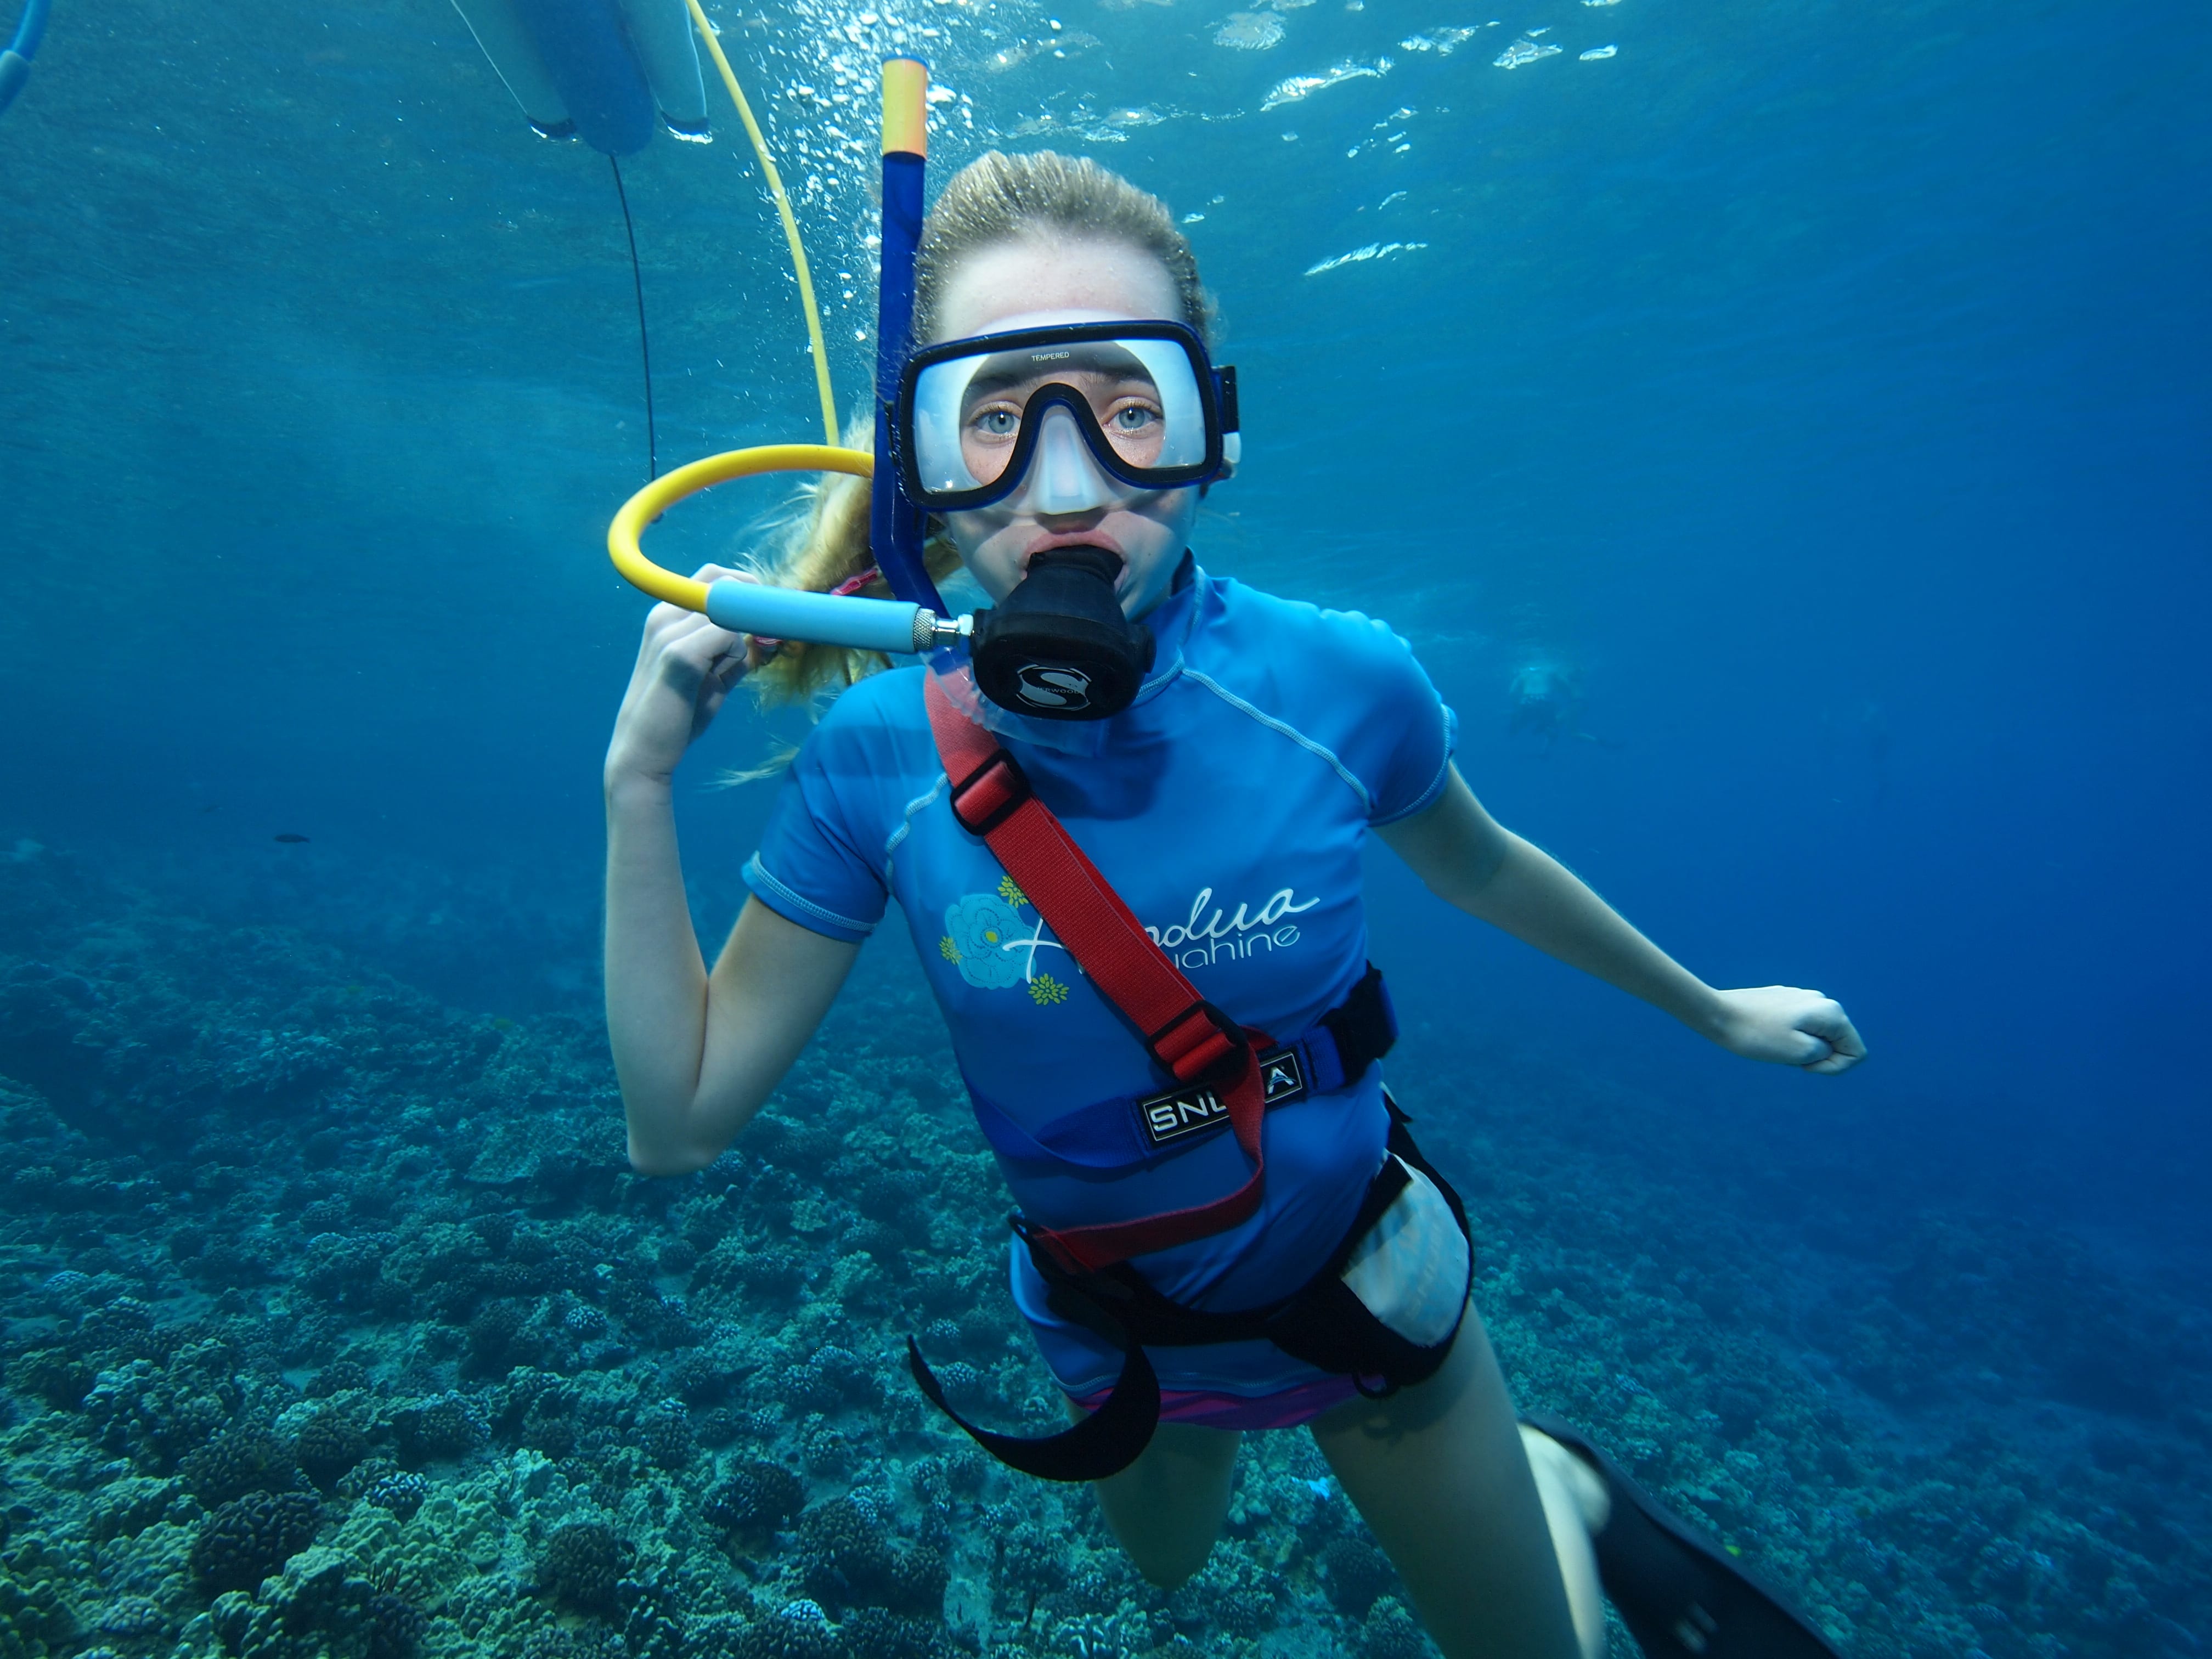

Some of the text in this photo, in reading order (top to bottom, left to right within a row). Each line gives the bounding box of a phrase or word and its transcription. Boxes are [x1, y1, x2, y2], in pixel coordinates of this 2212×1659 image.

[1031, 351, 1070, 362] TEMPERED
[1175, 924, 1301, 969] ahine
[1149, 1066, 1295, 1132] SNUA
